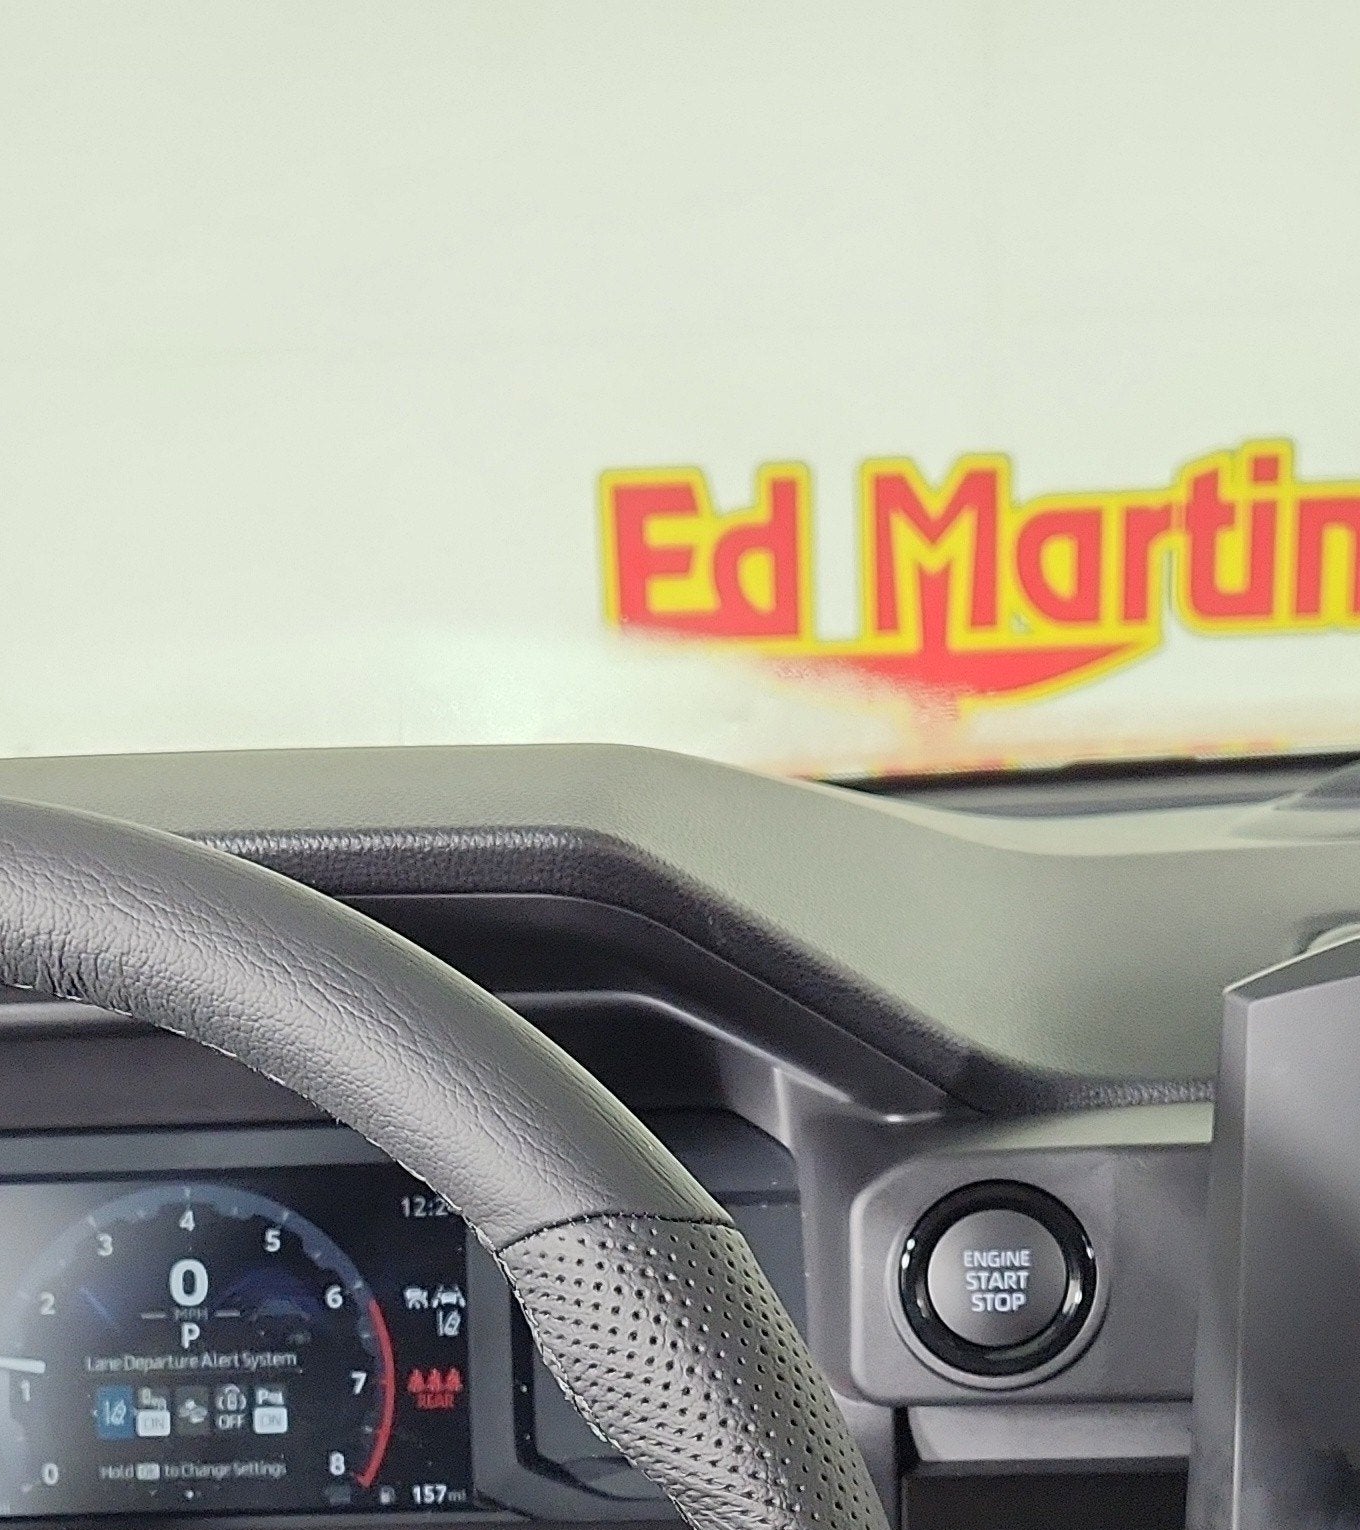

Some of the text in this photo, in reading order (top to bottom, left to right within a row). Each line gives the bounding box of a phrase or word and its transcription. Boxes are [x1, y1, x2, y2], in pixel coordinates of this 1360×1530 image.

[602, 463, 809, 643] Ed
[402, 1197, 459, 1217] 12:2
[178, 1210, 196, 1232] 4
[97, 1232, 114, 1256] 3
[265, 1230, 281, 1253] 5
[963, 1249, 1032, 1268] ENGINE
[169, 1258, 209, 1307] 0
[965, 1270, 1029, 1290] START
[40, 1291, 56, 1315] 2
[326, 1285, 343, 1309] 6
[971, 1292, 1027, 1312] STOP
[174, 1308, 209, 1321] MPH
[181, 1321, 201, 1349] P
[87, 1350, 298, 1373] Lane Departure Alert System
[20, 1379, 32, 1402] 1
[350, 1371, 366, 1394] 7
[217, 1413, 246, 1430] OFF
[42, 1463, 59, 1486] 0
[100, 1463, 133, 1479] Hold
[164, 1464, 178, 1478] to
[181, 1462, 231, 1480] Change
[233, 1460, 287, 1479] Settings
[330, 1451, 346, 1475] 8
[411, 1484, 447, 1502] 157
